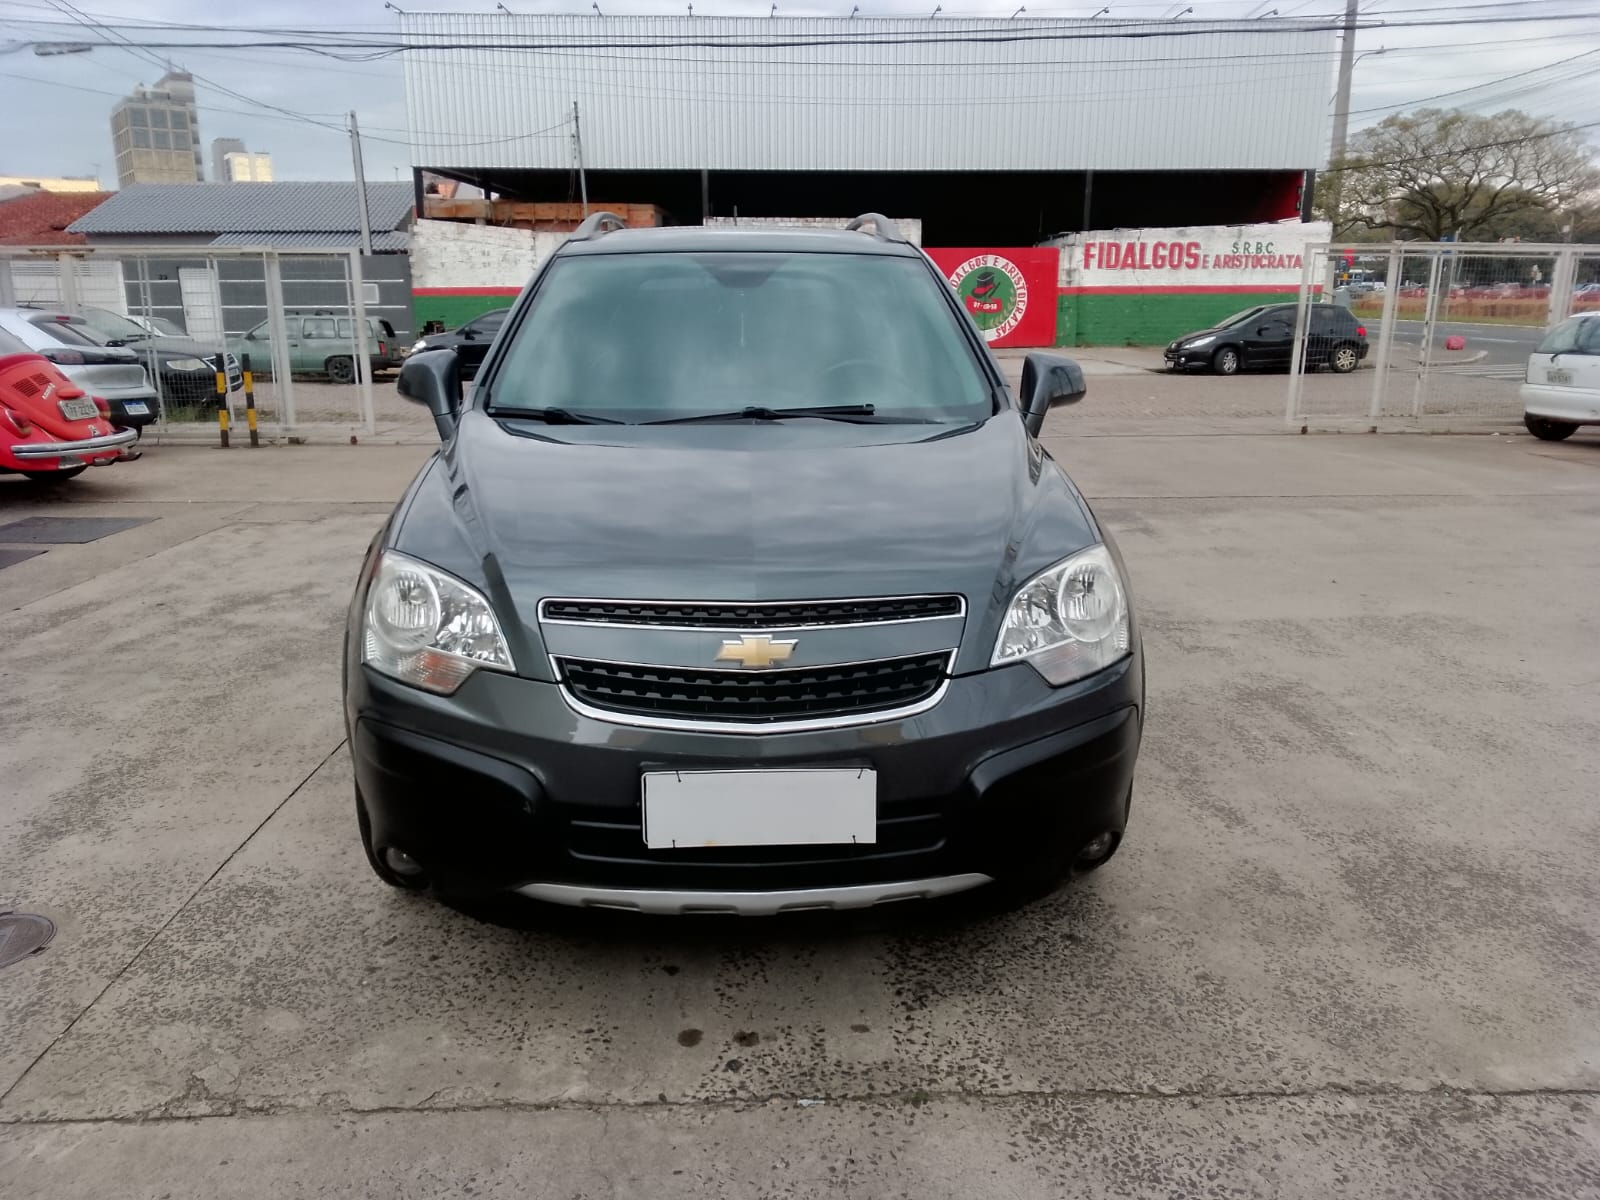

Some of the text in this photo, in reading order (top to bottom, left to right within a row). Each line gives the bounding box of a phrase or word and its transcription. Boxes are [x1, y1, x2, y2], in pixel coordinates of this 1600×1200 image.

[1083, 241, 1304, 271] FIDALGOS E ARISTOCRATA
[950, 256, 1027, 338] DALGOS E ARISTOCRATAS
